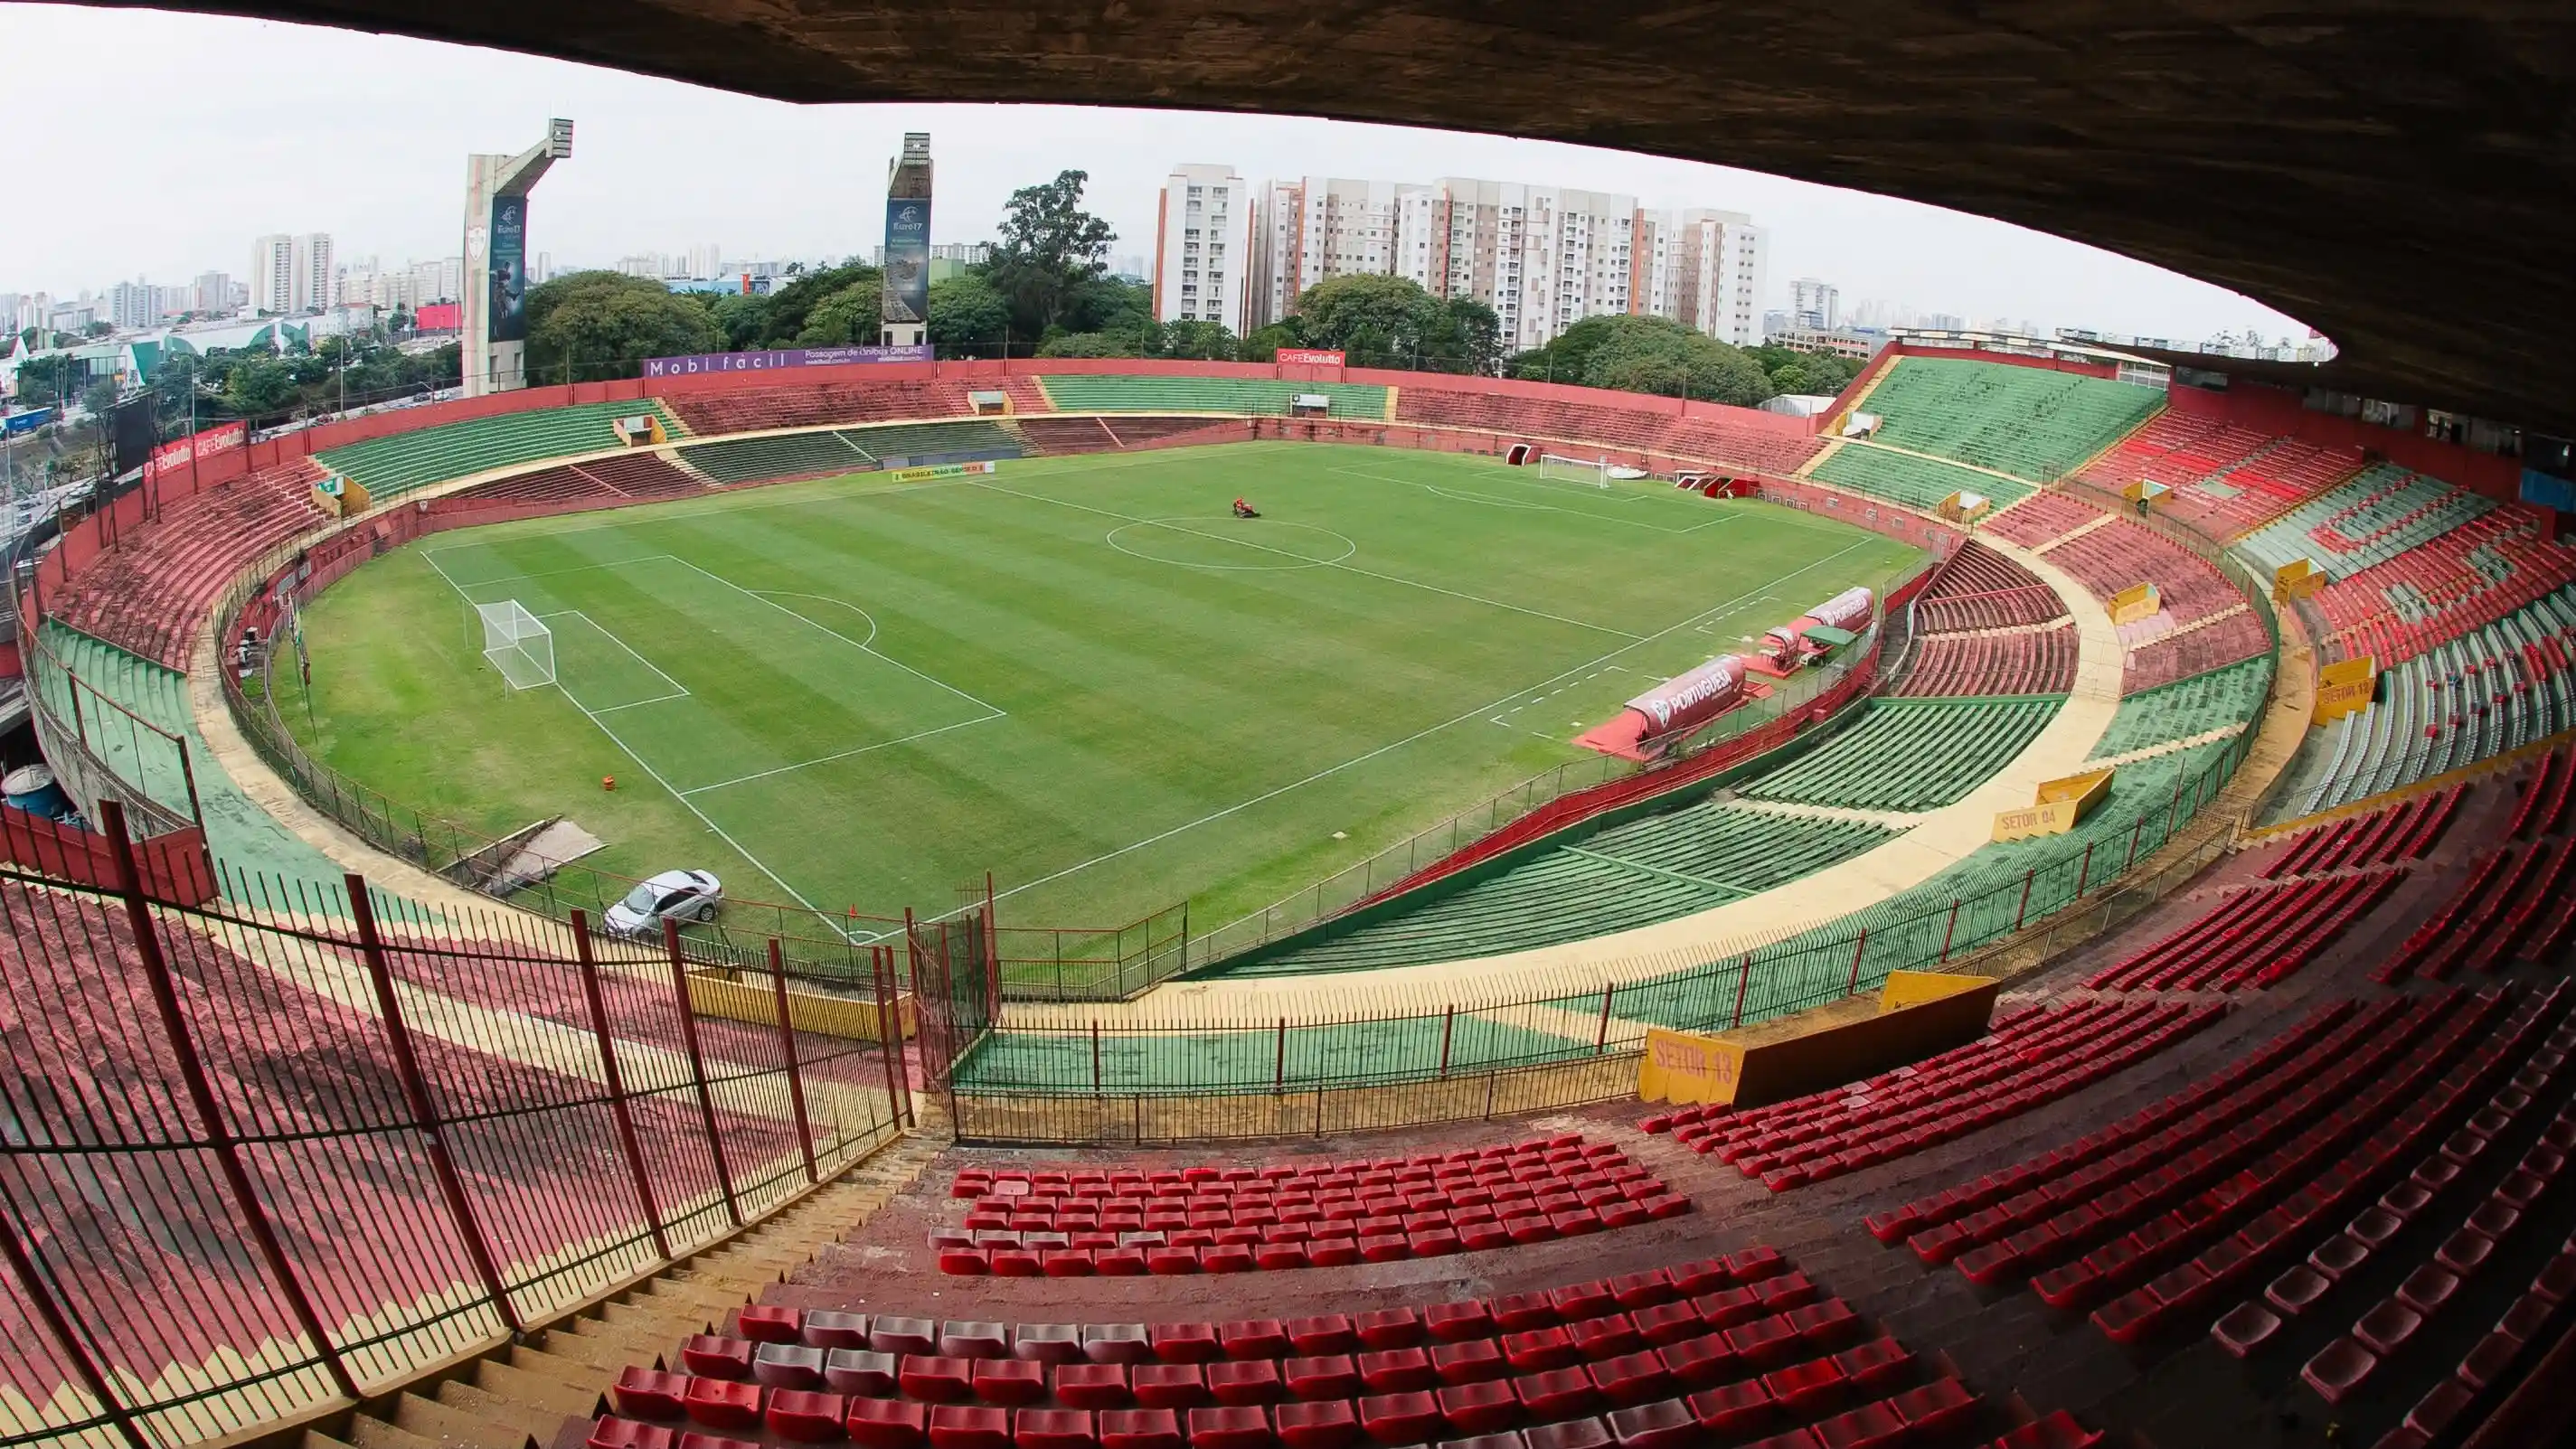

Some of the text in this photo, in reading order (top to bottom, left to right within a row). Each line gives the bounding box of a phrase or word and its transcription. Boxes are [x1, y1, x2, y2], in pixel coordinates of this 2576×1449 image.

[846, 348, 858, 356] de
[890, 345, 923, 354] ONLINE
[650, 357, 709, 377] Mobi
[1670, 668, 1732, 715] PORTUGUESA
[2358, 680, 2373, 695] 12
[2001, 808, 2056, 830] SETOR 04
[1655, 1039, 1732, 1084] SETOR 13
